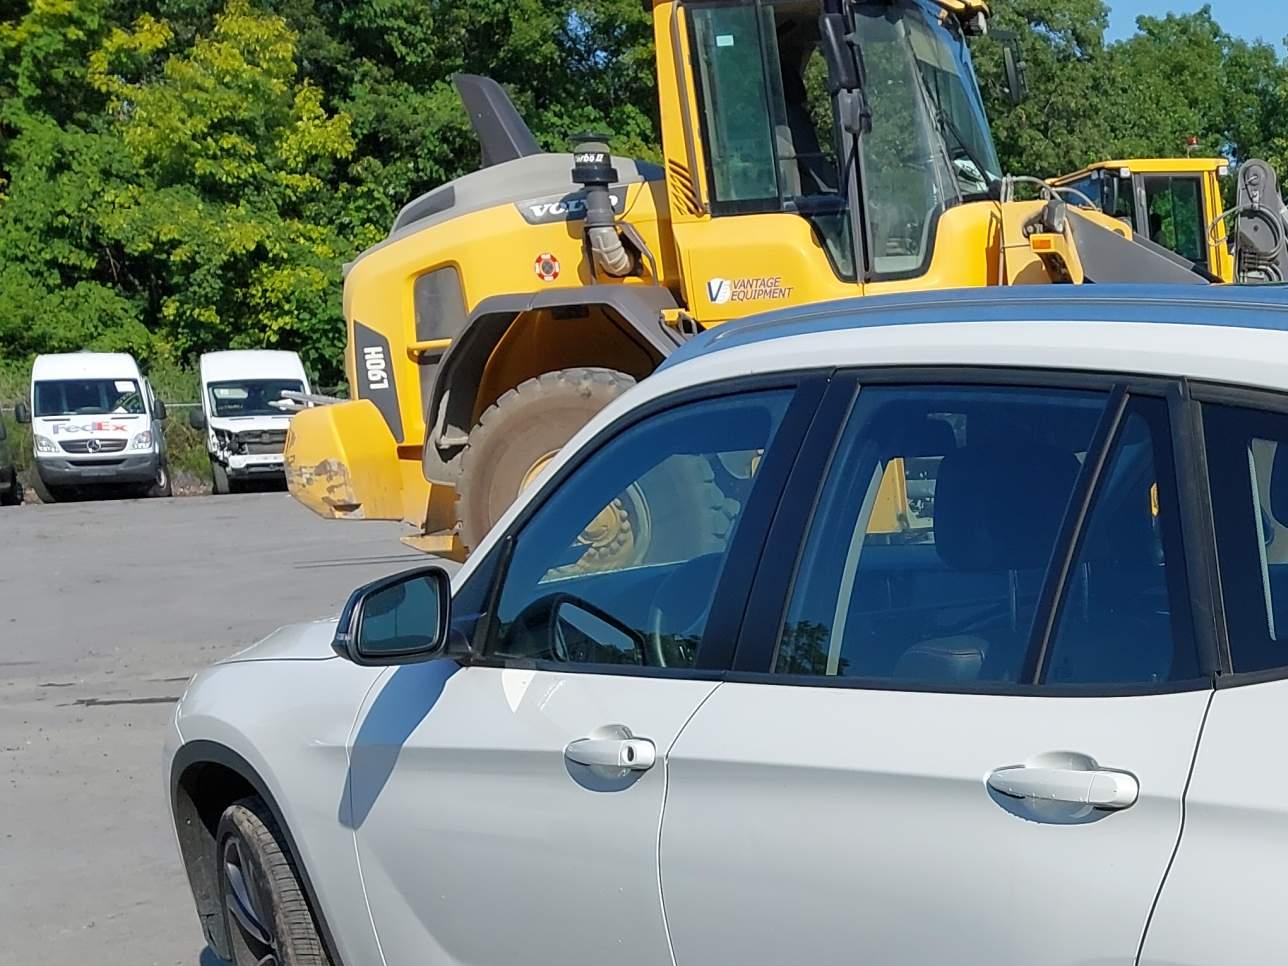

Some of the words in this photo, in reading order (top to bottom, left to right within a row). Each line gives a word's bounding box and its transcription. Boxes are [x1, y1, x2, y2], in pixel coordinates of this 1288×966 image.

[733, 278, 781, 289] VANTAGE
[731, 288, 793, 301] EQUIPMENT
[364, 347, 389, 390] L90H
[53, 422, 127, 434] FedEx
